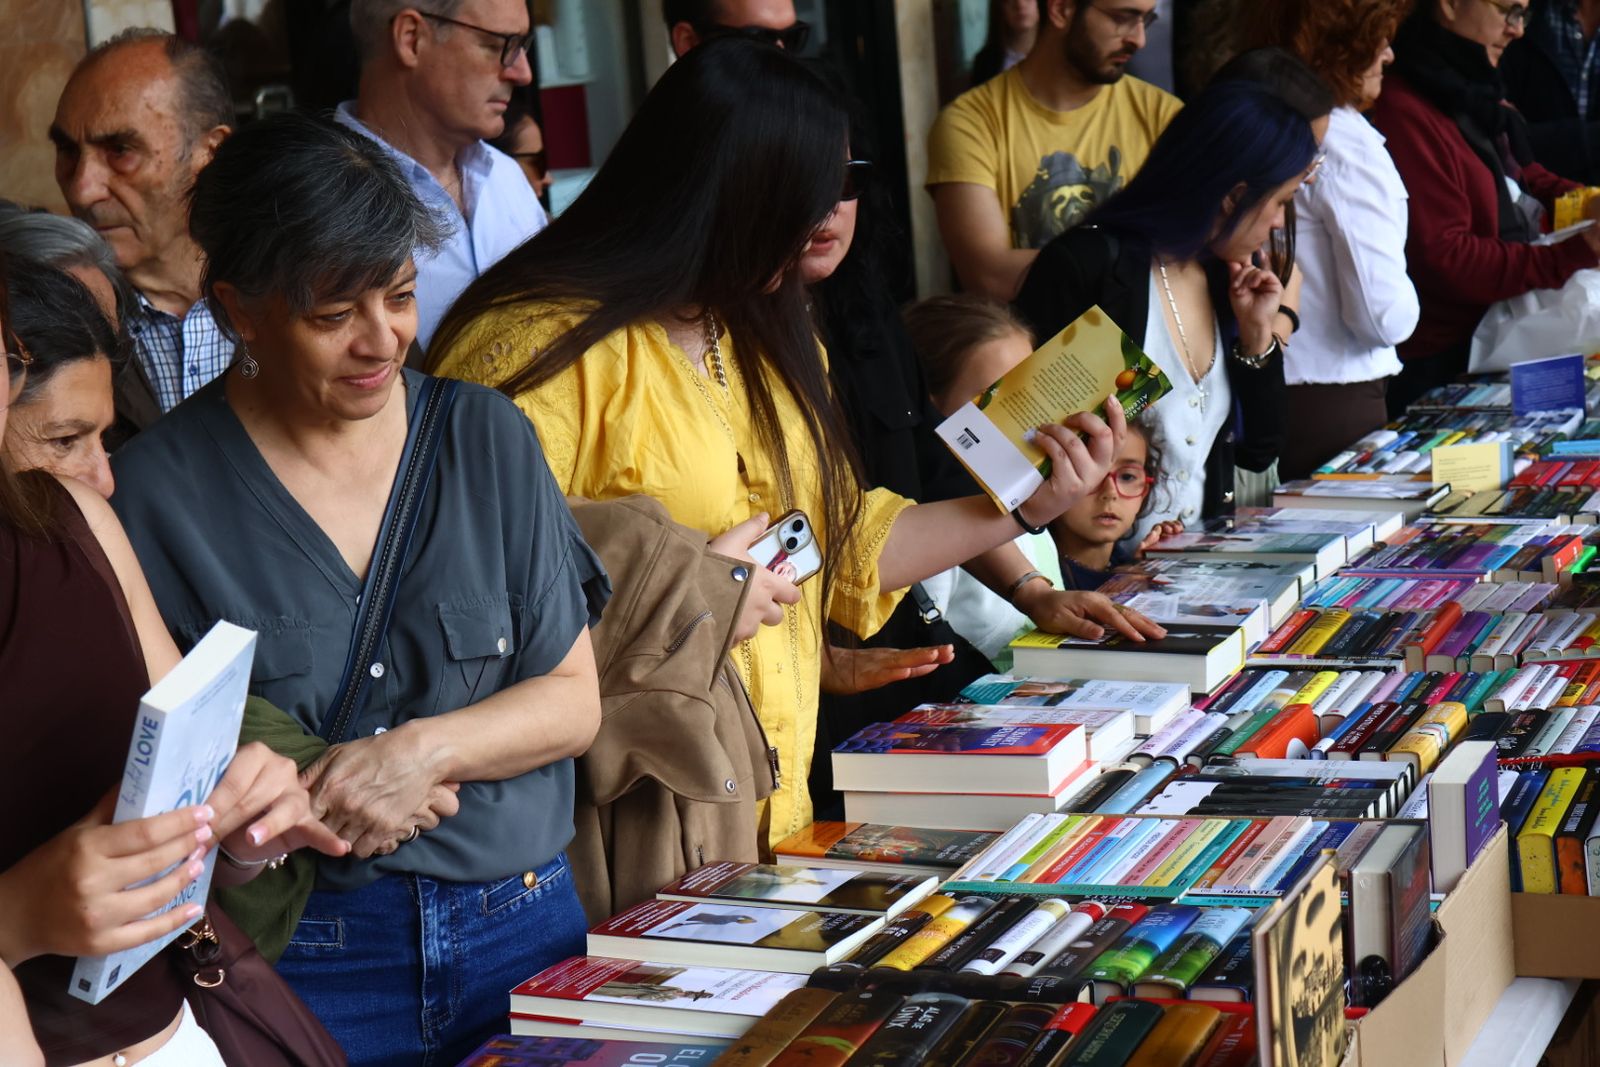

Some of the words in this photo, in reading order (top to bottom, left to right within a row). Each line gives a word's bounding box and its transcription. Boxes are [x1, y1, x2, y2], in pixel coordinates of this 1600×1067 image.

[1124, 394, 1148, 415] ALLEND
[136, 716, 159, 766] LOVE
[885, 1005, 923, 1030] ÓNIX
[917, 1005, 942, 1024] ALAS
